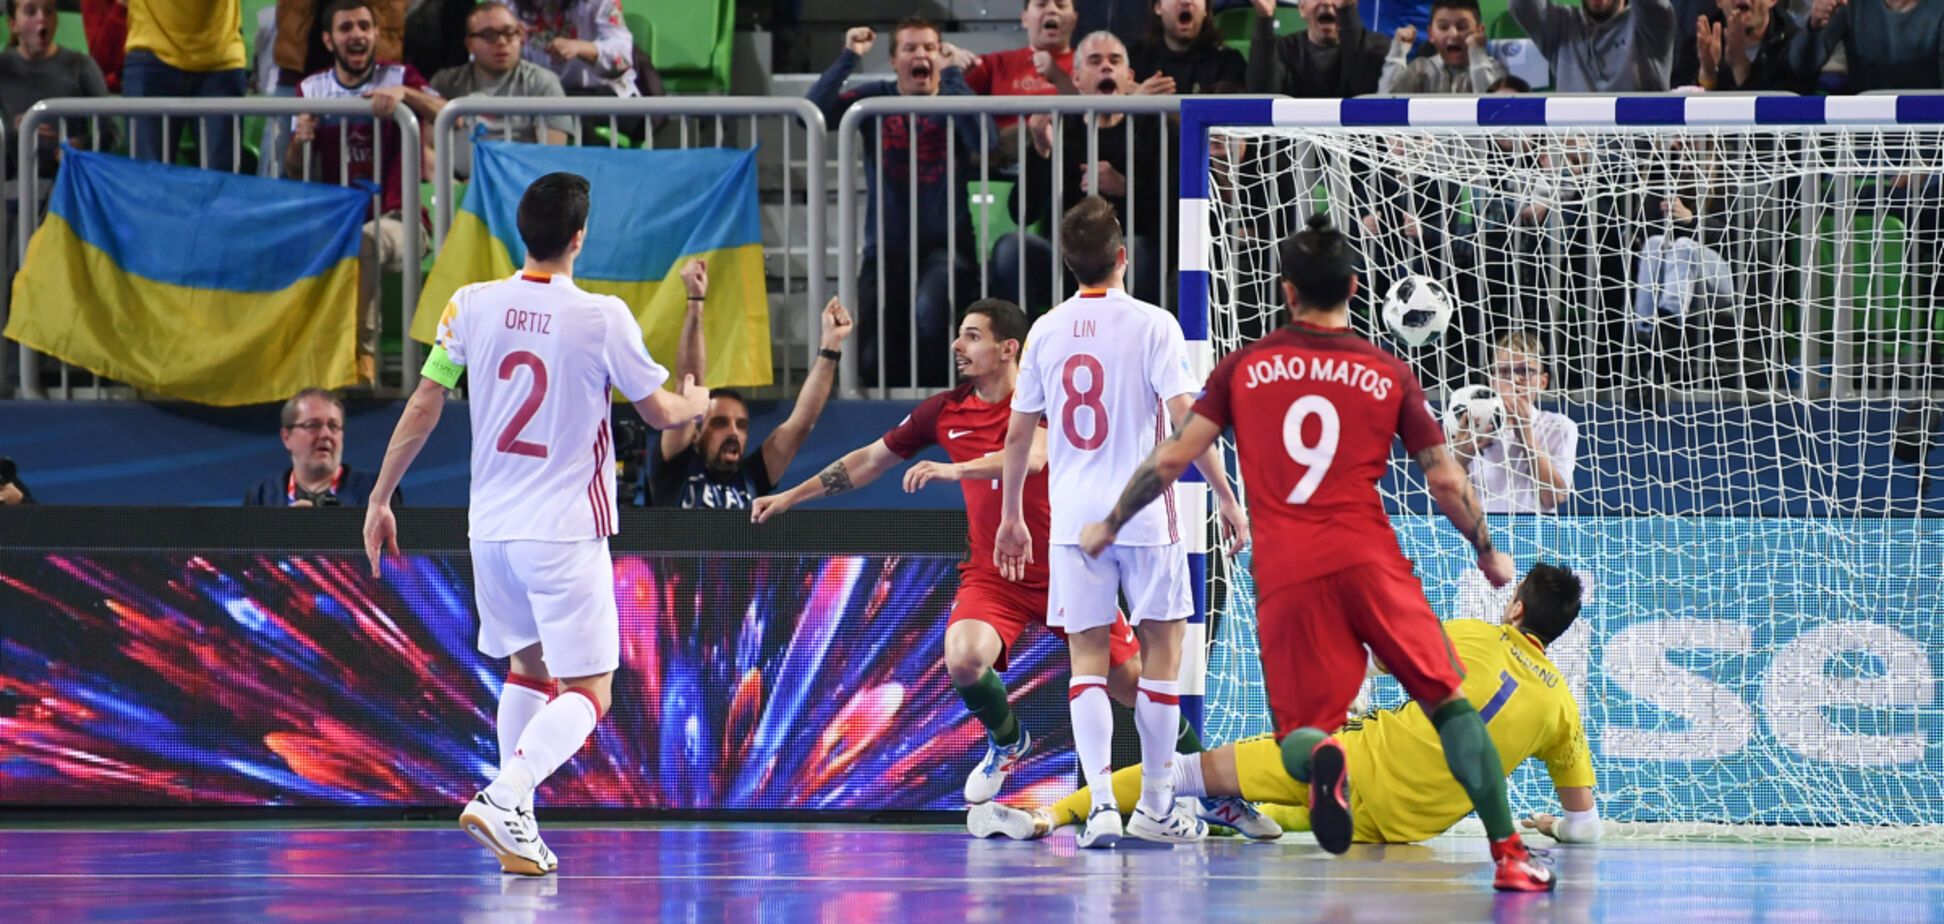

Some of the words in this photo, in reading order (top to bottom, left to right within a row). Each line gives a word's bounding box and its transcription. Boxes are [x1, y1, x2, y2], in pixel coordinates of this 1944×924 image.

[505, 308, 552, 335] ORTIZ
[1073, 320, 1096, 338] LIN
[1062, 353, 1109, 451] 8
[1246, 354, 1306, 389] JOÃO
[1310, 357, 1393, 400] MATOS
[497, 351, 548, 458] 2
[1283, 394, 1340, 504] 9
[1479, 670, 1518, 724] 1
